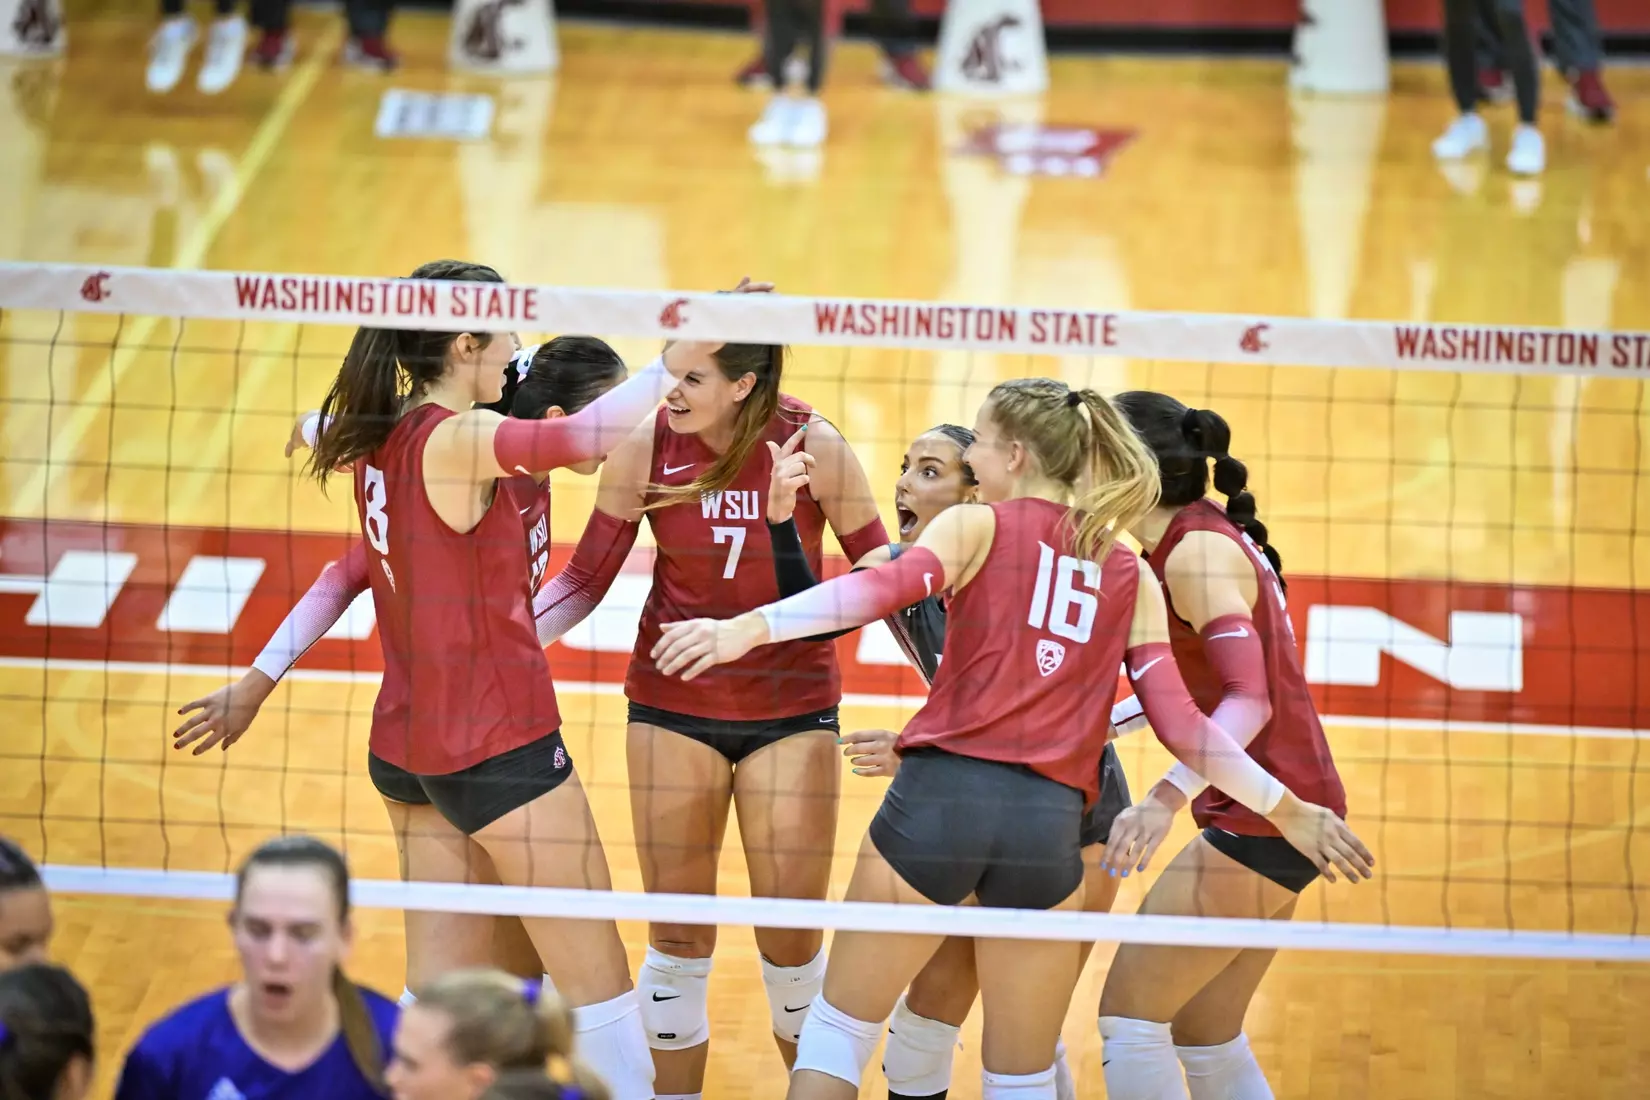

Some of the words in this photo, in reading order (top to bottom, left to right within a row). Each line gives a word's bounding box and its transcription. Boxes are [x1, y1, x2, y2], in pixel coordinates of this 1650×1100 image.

[234, 275, 437, 317] WASHINGTON
[451, 286, 538, 321] STATE
[813, 301, 1016, 342] WASHINGTON
[1029, 311, 1118, 346] STATE
[1394, 325, 1599, 368] WASHINGTON
[1611, 334, 1650, 369] ST
[364, 464, 389, 555] 8
[701, 490, 760, 520] WSU
[710, 526, 747, 579] 7
[1027, 540, 1102, 644] 16
